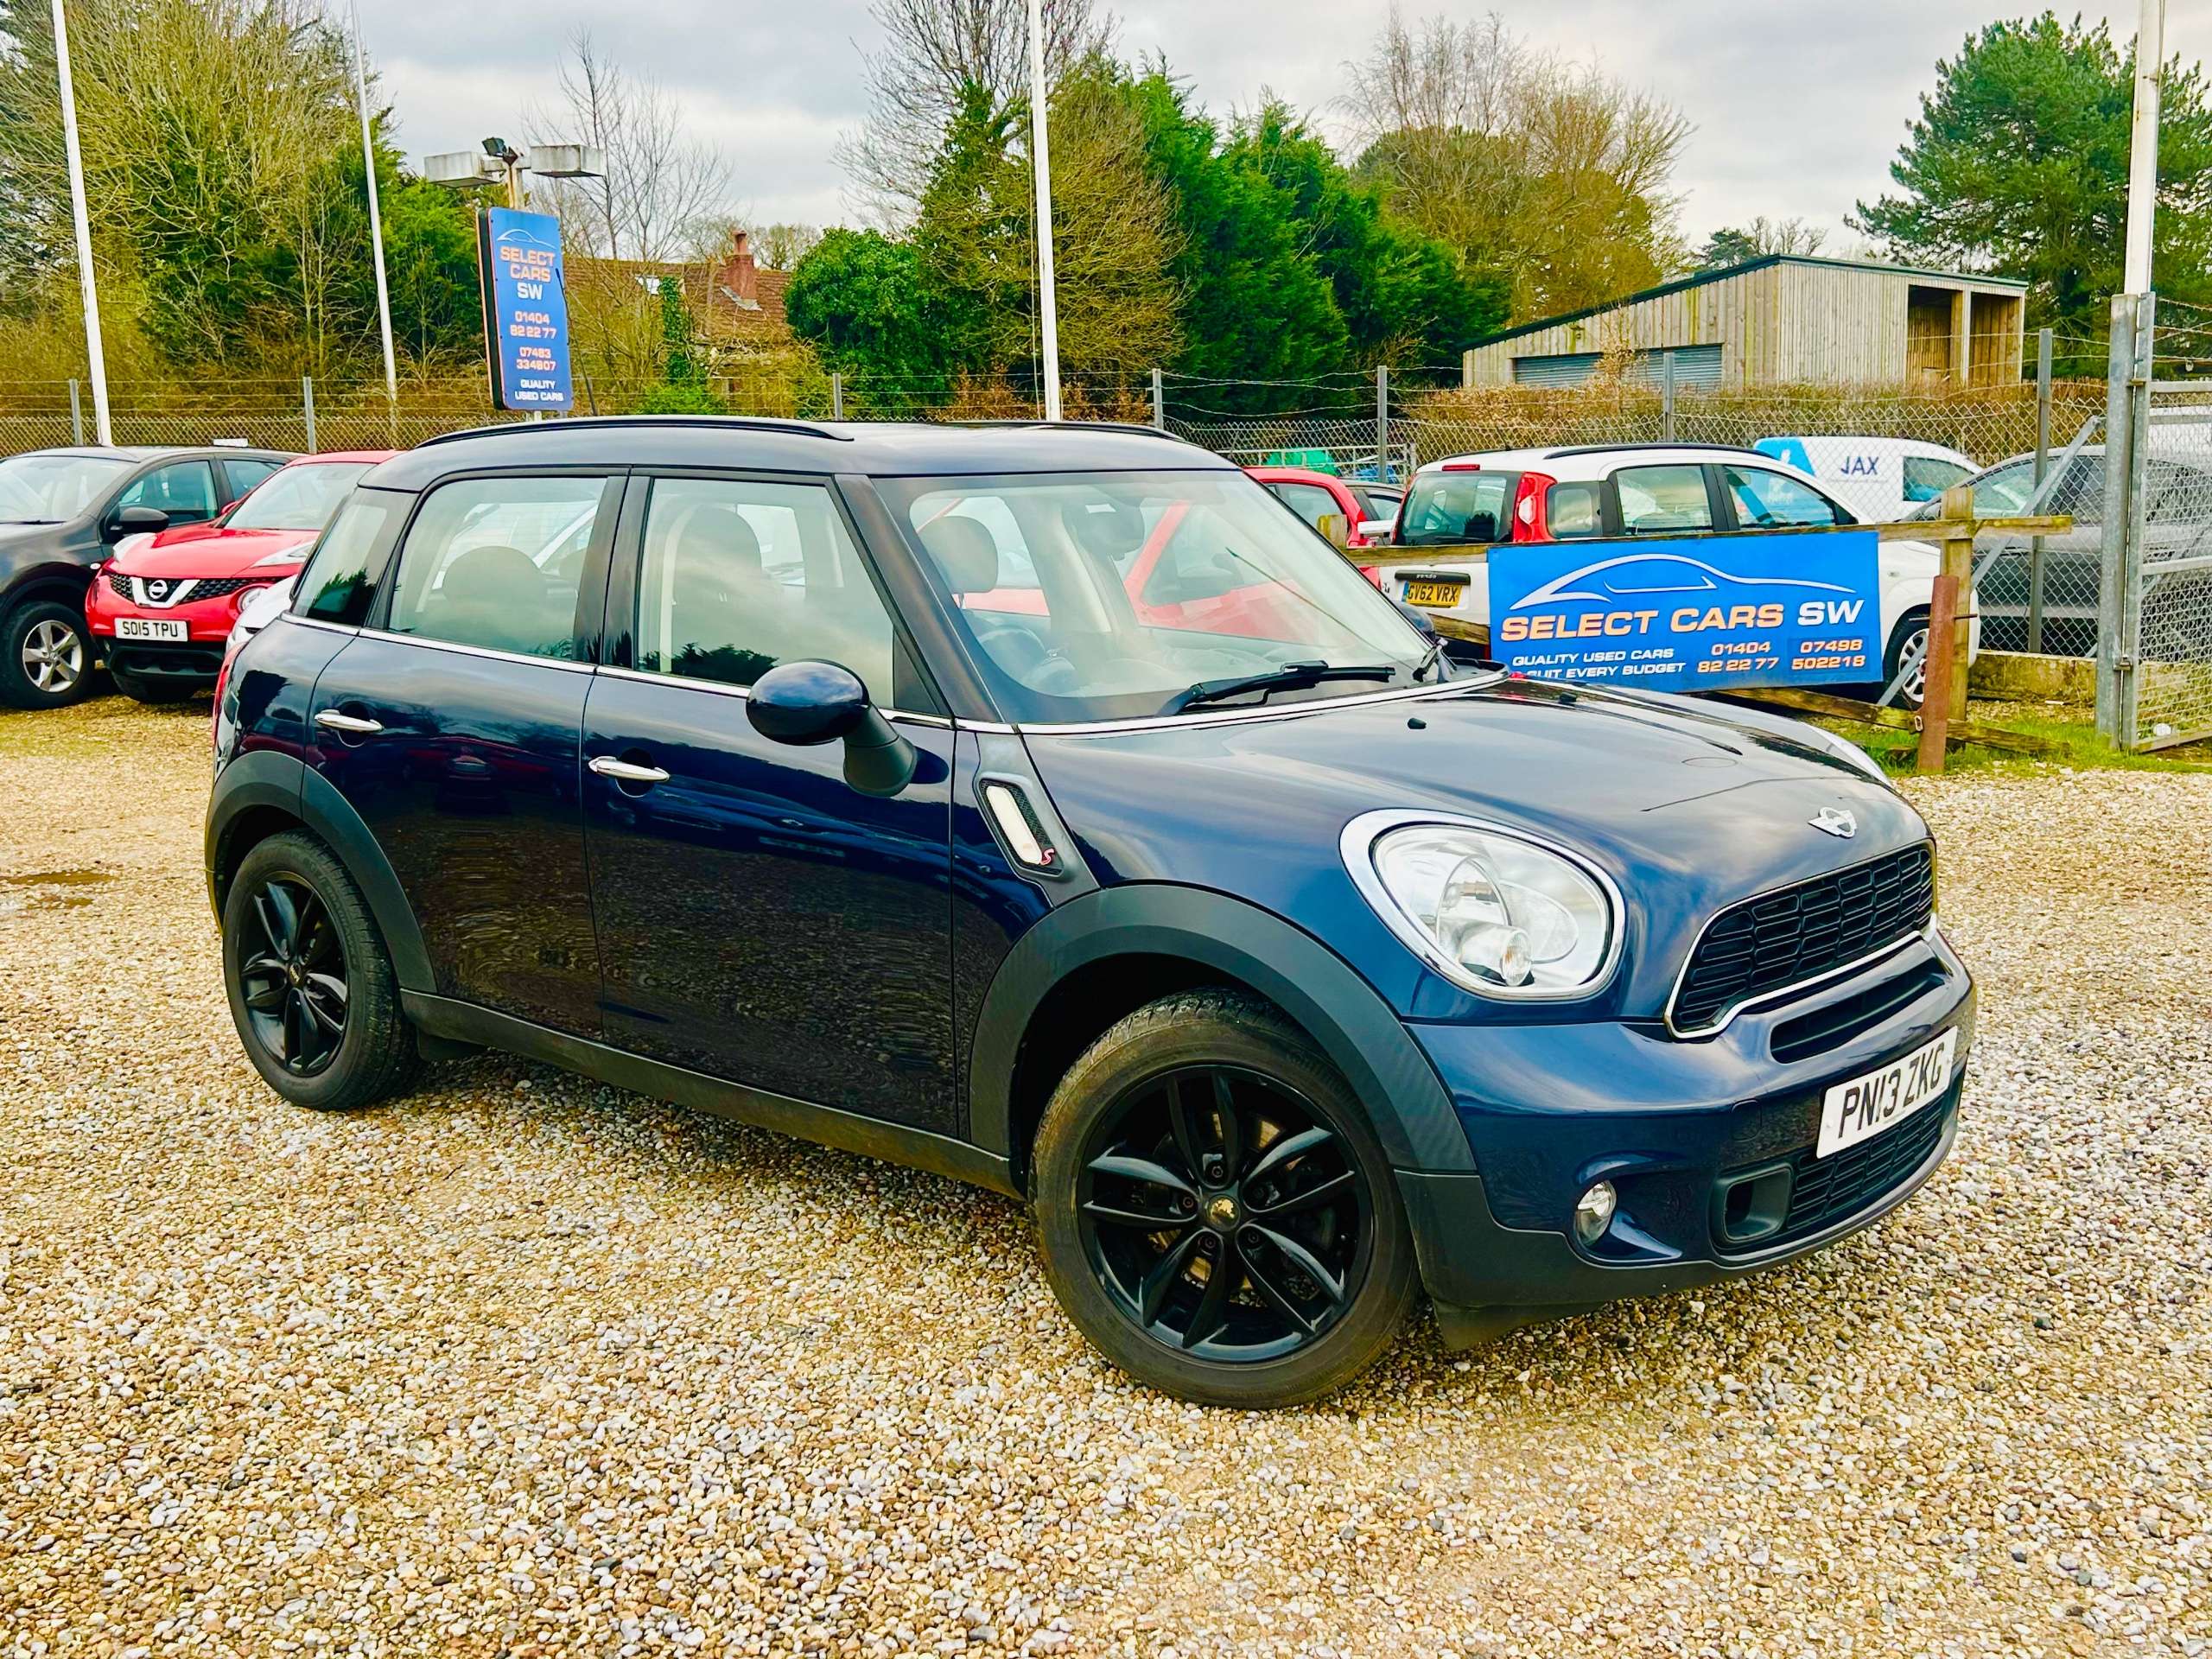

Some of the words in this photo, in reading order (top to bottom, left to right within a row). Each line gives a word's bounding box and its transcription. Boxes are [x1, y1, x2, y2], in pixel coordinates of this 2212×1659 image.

[500, 246, 555, 267] SELECT
[511, 263, 551, 283] CARS
[518, 282, 543, 300] SW
[515, 311, 550, 325] 01404
[520, 379, 556, 390] QUALITY
[514, 391, 538, 401] USED
[539, 391, 564, 402] CARS
[1840, 456, 1879, 475] JAX
[1435, 586, 1459, 602] VRX
[1500, 609, 1660, 642] SELECT
[1669, 603, 1784, 633] CARS
[1796, 599, 1865, 626] SW
[152, 622, 178, 638] TPU
[1711, 641, 1771, 656] 01404
[1800, 639, 1864, 653] 07498
[1512, 653, 1580, 667] QUALITY
[1583, 651, 1626, 663] USED
[1630, 648, 1675, 660] CARS
[1791, 655, 1866, 670] 502218
[1566, 666, 1619, 678] EVERY
[1622, 662, 1687, 676] BUDGET
[1039, 848, 1055, 865] S
[1838, 1068, 1902, 1140] PN13
[1904, 1041, 1945, 1108] ZKG
